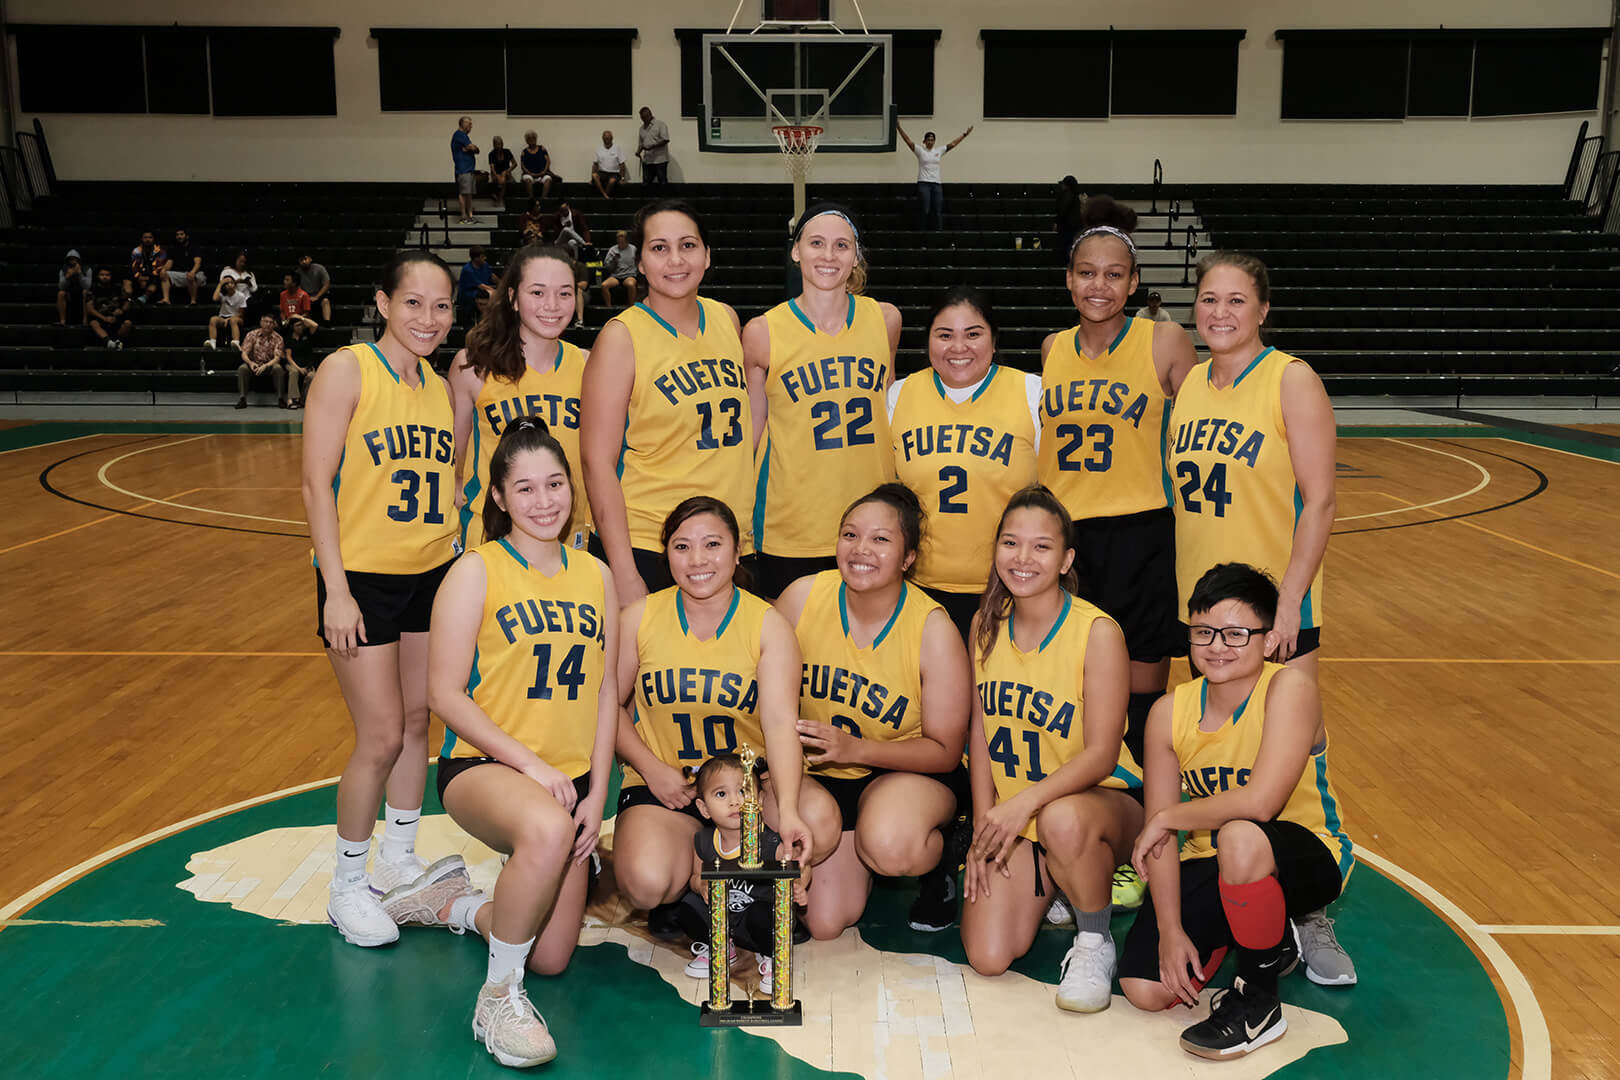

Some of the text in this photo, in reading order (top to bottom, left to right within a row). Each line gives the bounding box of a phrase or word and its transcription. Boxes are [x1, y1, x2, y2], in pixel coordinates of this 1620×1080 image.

[696, 397, 743, 450] 13
[811, 397, 875, 451] 22
[1038, 379, 1149, 430] UETSA
[363, 424, 456, 467] FUETS
[901, 424, 1014, 467] FUETSA
[1056, 424, 1114, 472] 23
[1170, 418, 1265, 469] UETSA
[387, 469, 444, 524] 31
[939, 465, 968, 514] 2
[1176, 461, 1232, 517] 24
[527, 644, 586, 701] 14
[641, 668, 758, 714] FUETSA
[672, 713, 737, 760] 10
[988, 726, 1048, 782] 41
